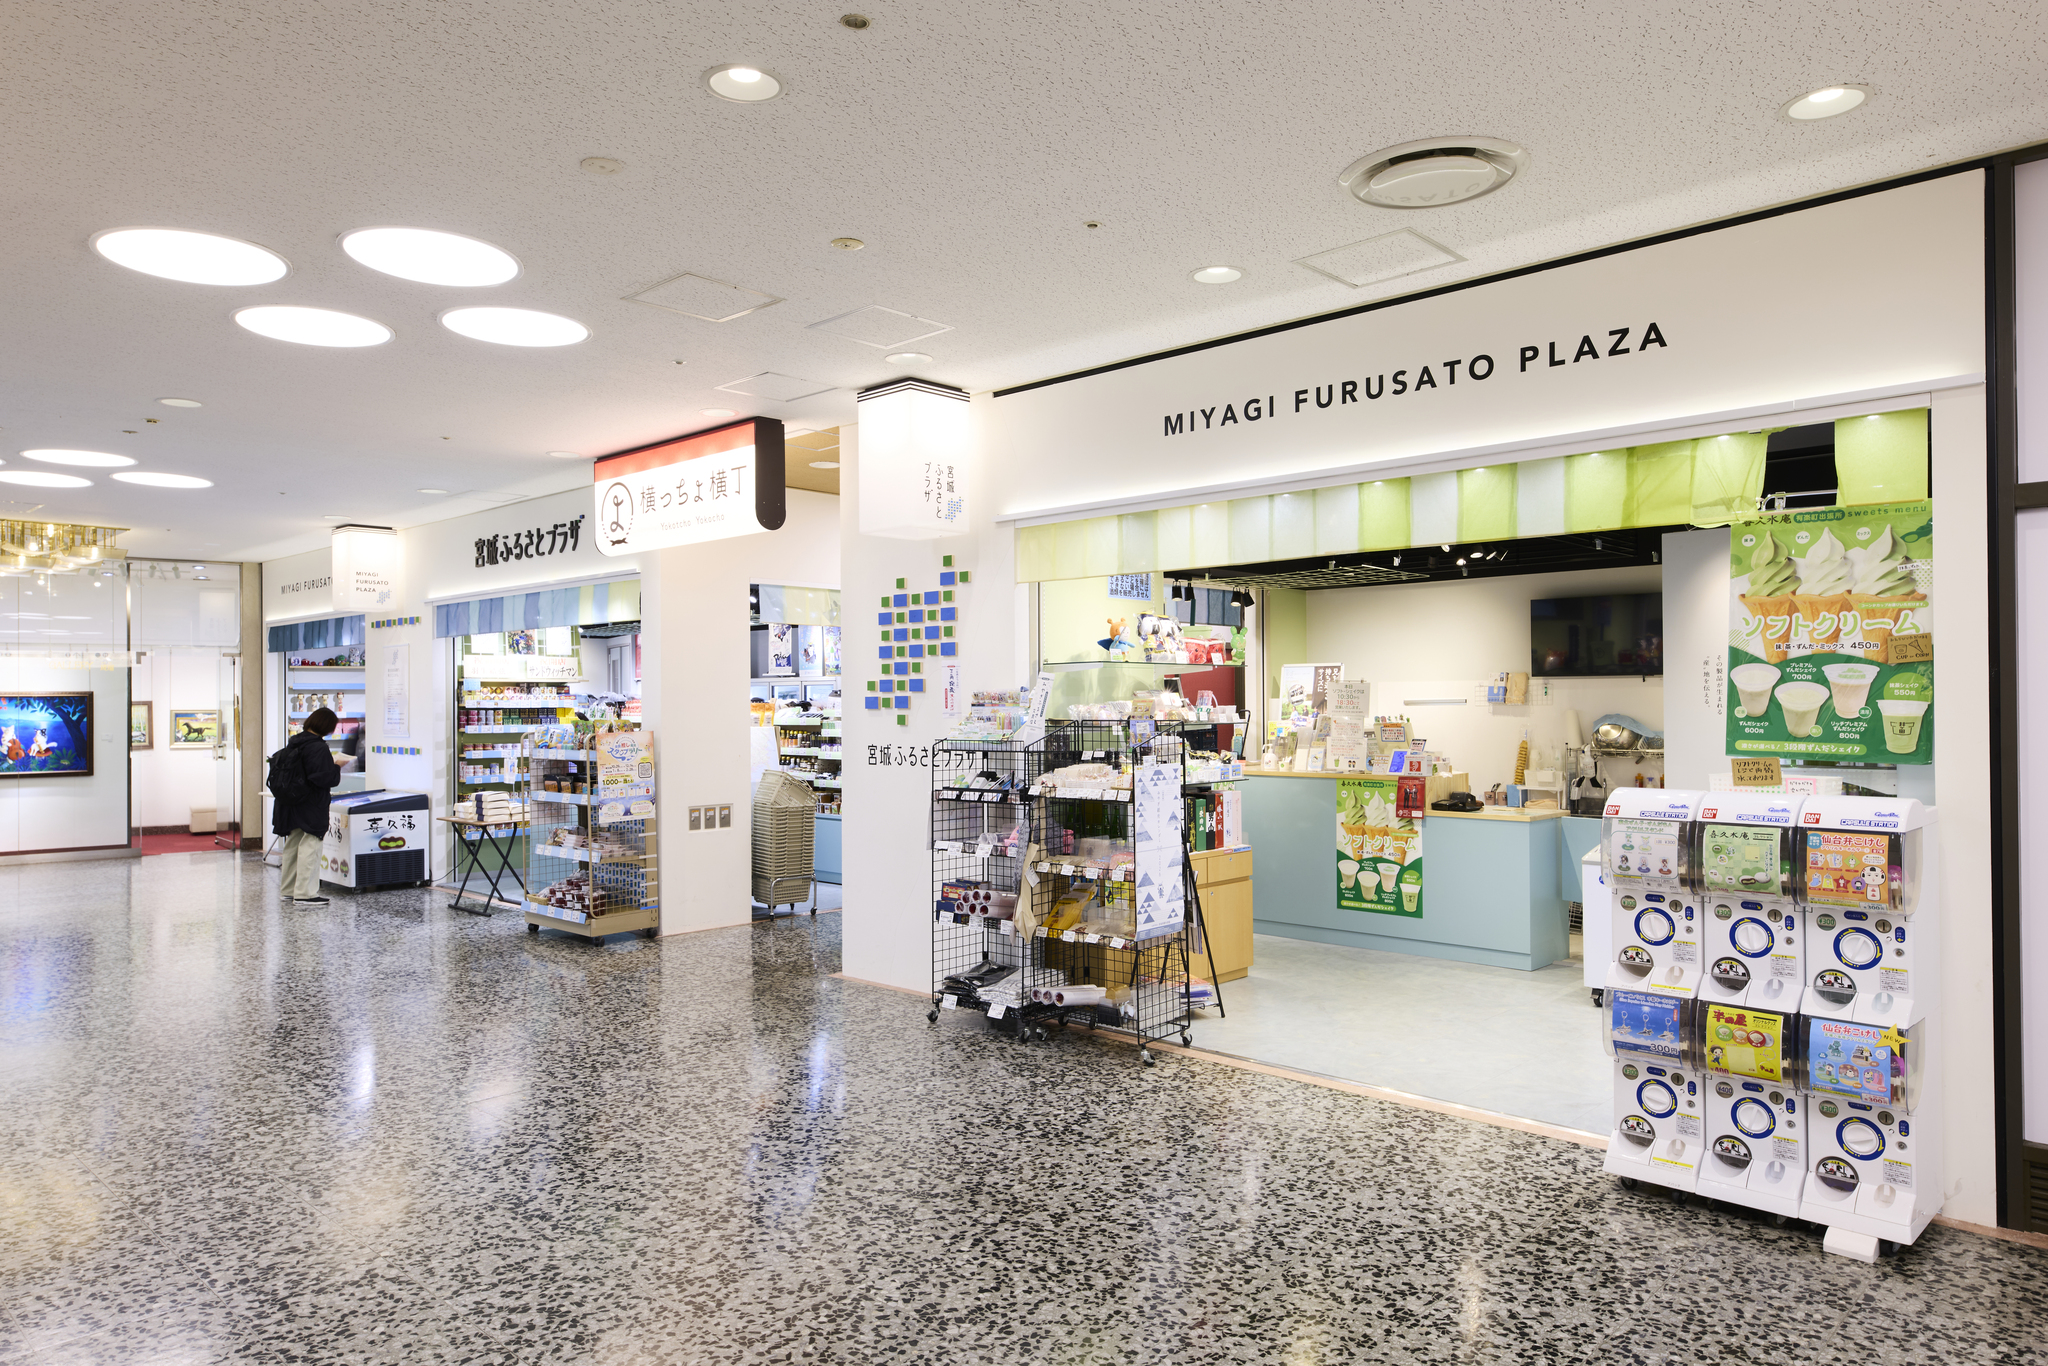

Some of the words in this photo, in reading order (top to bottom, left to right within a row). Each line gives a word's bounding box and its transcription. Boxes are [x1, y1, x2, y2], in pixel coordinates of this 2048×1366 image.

[1164, 395, 1276, 437] MIYAGI
[1293, 353, 1495, 414] FURUSATO
[1519, 321, 1669, 373] PLAZA
[924, 461, 934, 503] プラザ
[946, 465, 955, 493] 宮城
[640, 465, 748, 514] 横っちょ横丁
[935, 463, 944, 519] ふるさと
[695, 513, 725, 526] Yokocho
[1796, 510, 1843, 522] 有楽町出張所
[1847, 507, 1889, 517] sweets
[1895, 504, 1927, 514] menu
[474, 514, 585, 568] 宮城ふるさとプラザ
[281, 582, 302, 595] MIYAGI
[304, 576, 333, 592] FURUSAT
[1741, 610, 1923, 639] ソフトクリーム
[1850, 642, 1880, 650] 450円
[529, 666, 578, 677] サンドウィッチマン
[1317, 668, 1325, 692] サイズに
[1715, 654, 1723, 715] その製品が生まれる
[1839, 732, 1860, 740] 800円
[1784, 742, 1861, 754] 3段階ずんだシェイク
[1341, 780, 1362, 788] 喜久水庵
[363, 814, 416, 833] 喜久福
[1736, 814, 1764, 822] CAPSULE
[1764, 815, 1789, 823] STATION
[1870, 820, 1898, 828] STATION
[1342, 834, 1417, 851] ソフトクリーム
[1709, 830, 1750, 840] 喜久水庵
[1821, 834, 1886, 848] 仙台弁こけし
[1819, 918, 1835, 926] ¥300
[1712, 1009, 1747, 1027] 半田屋
[1821, 1023, 1880, 1040] 仙台弁こけし
[1883, 1034, 1901, 1044] NEW
[1650, 1043, 1678, 1055] 300円
[1821, 1105, 1837, 1113] ¥300
